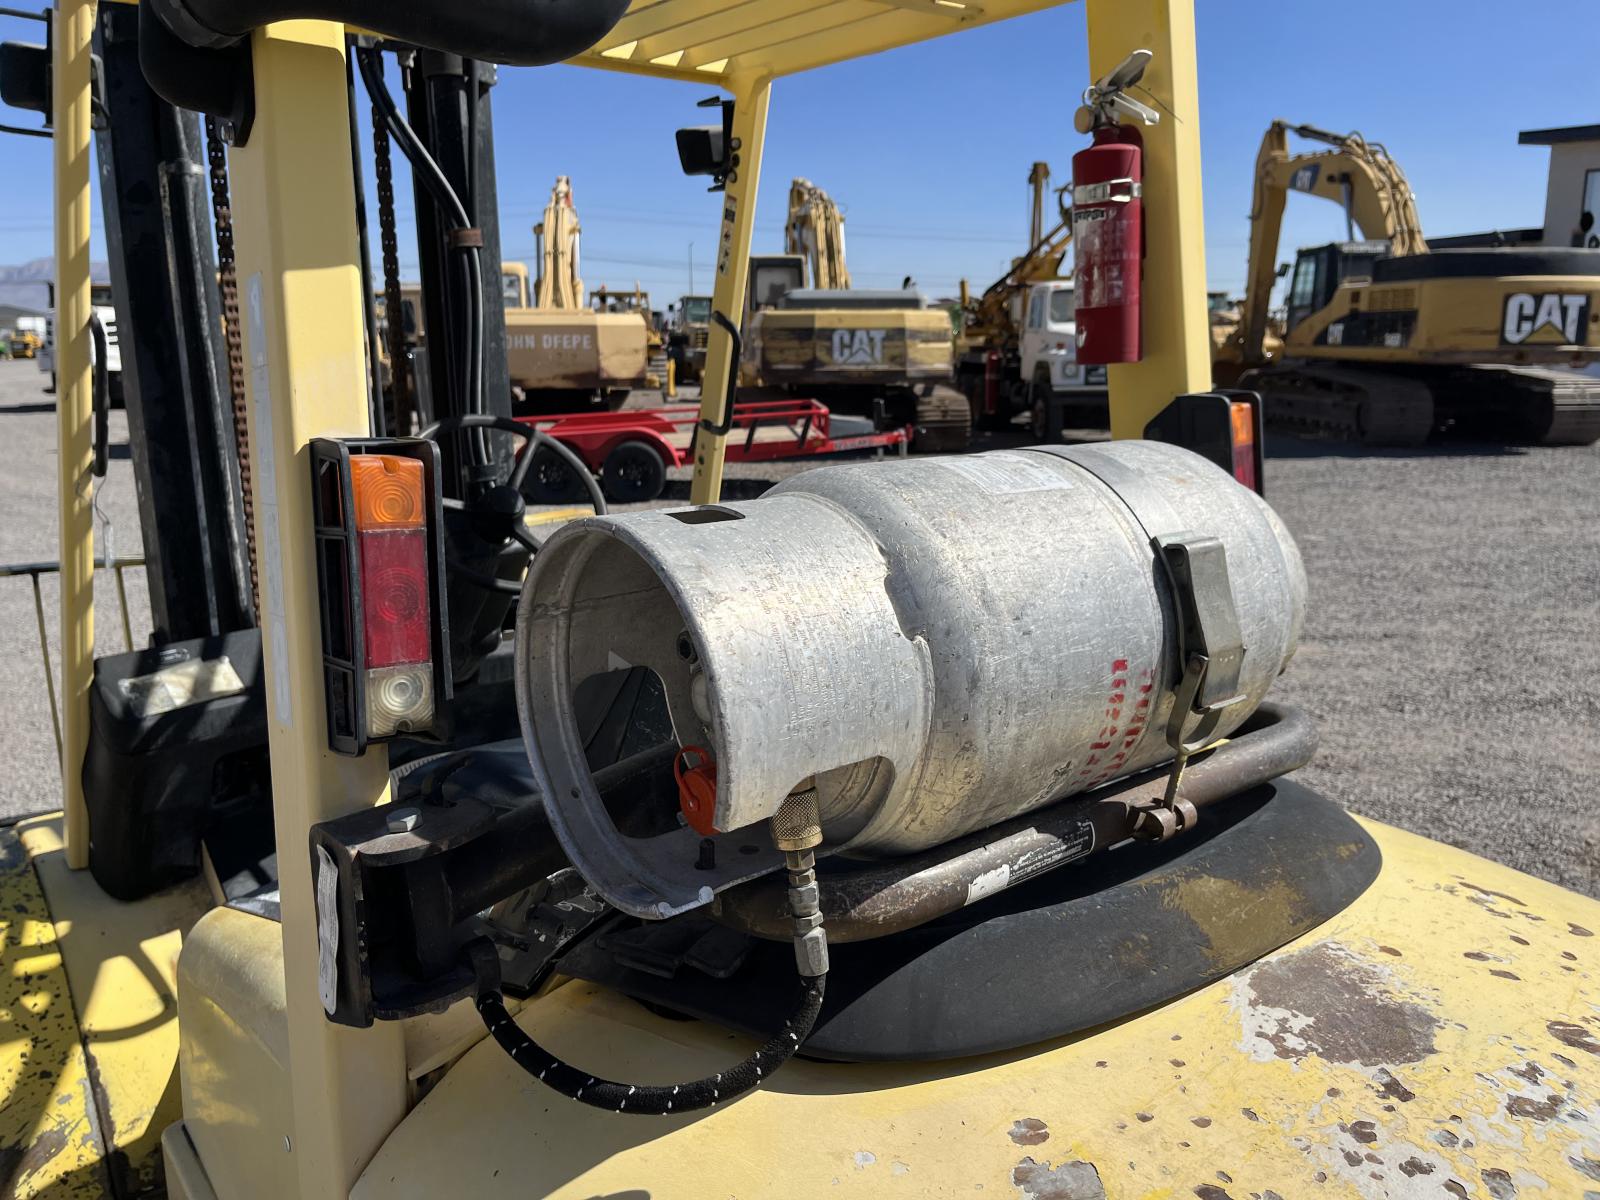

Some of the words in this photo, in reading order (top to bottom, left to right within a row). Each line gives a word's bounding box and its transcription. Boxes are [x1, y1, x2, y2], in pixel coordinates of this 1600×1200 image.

[1504, 294, 1587, 344] CAT
[506, 334, 535, 350] OHN
[832, 329, 887, 364] CAT
